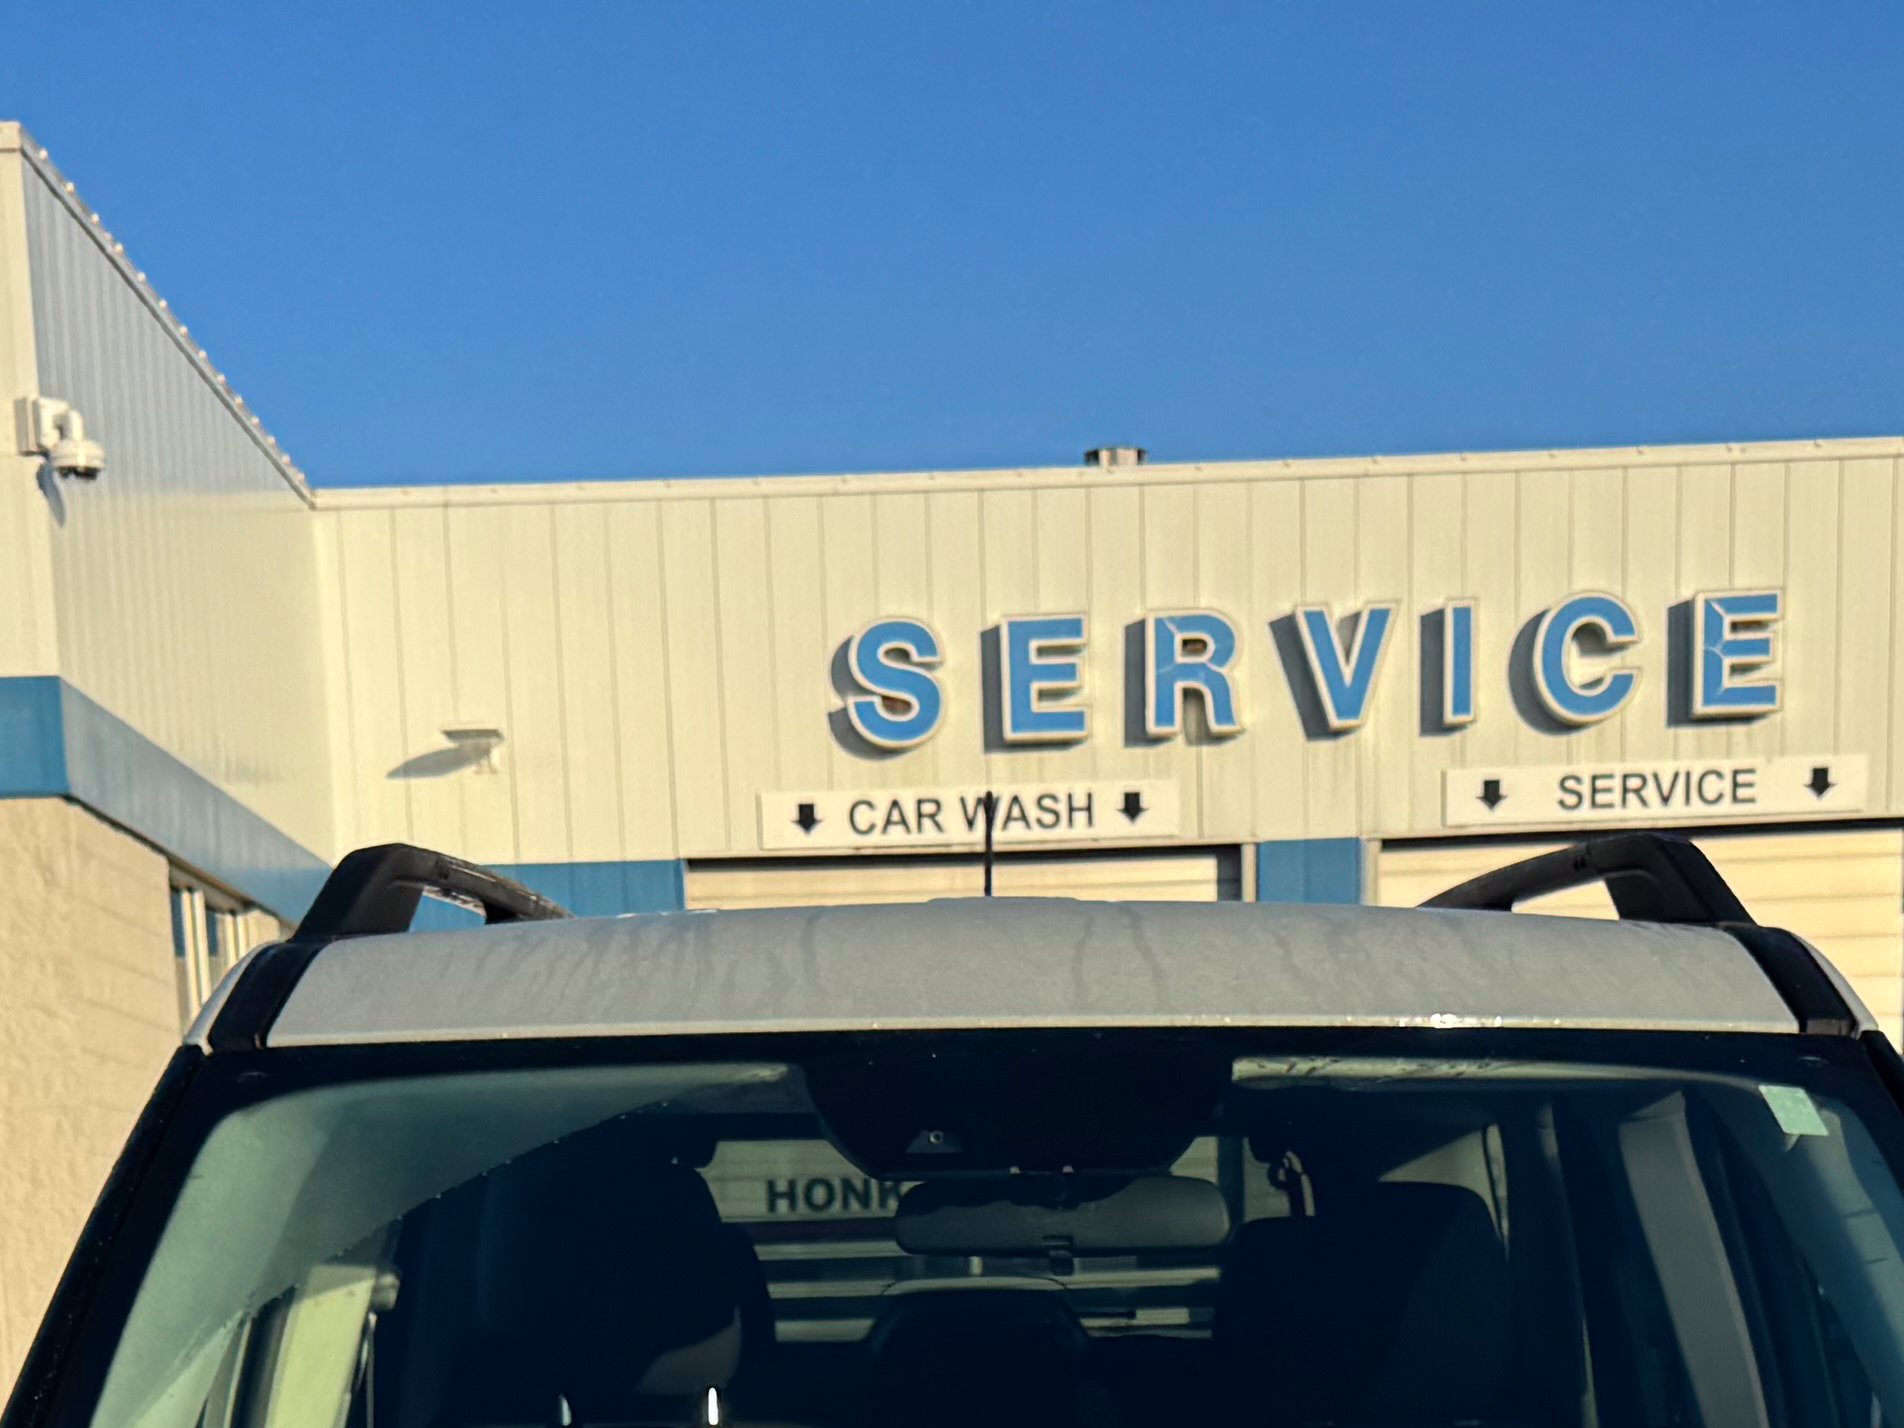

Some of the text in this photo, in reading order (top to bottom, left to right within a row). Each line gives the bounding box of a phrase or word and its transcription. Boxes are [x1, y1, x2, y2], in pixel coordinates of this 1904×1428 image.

[845, 590, 1786, 748] SERVICE
[1557, 768, 1757, 812] SERVICE
[848, 791, 1095, 836] CAR WASH
